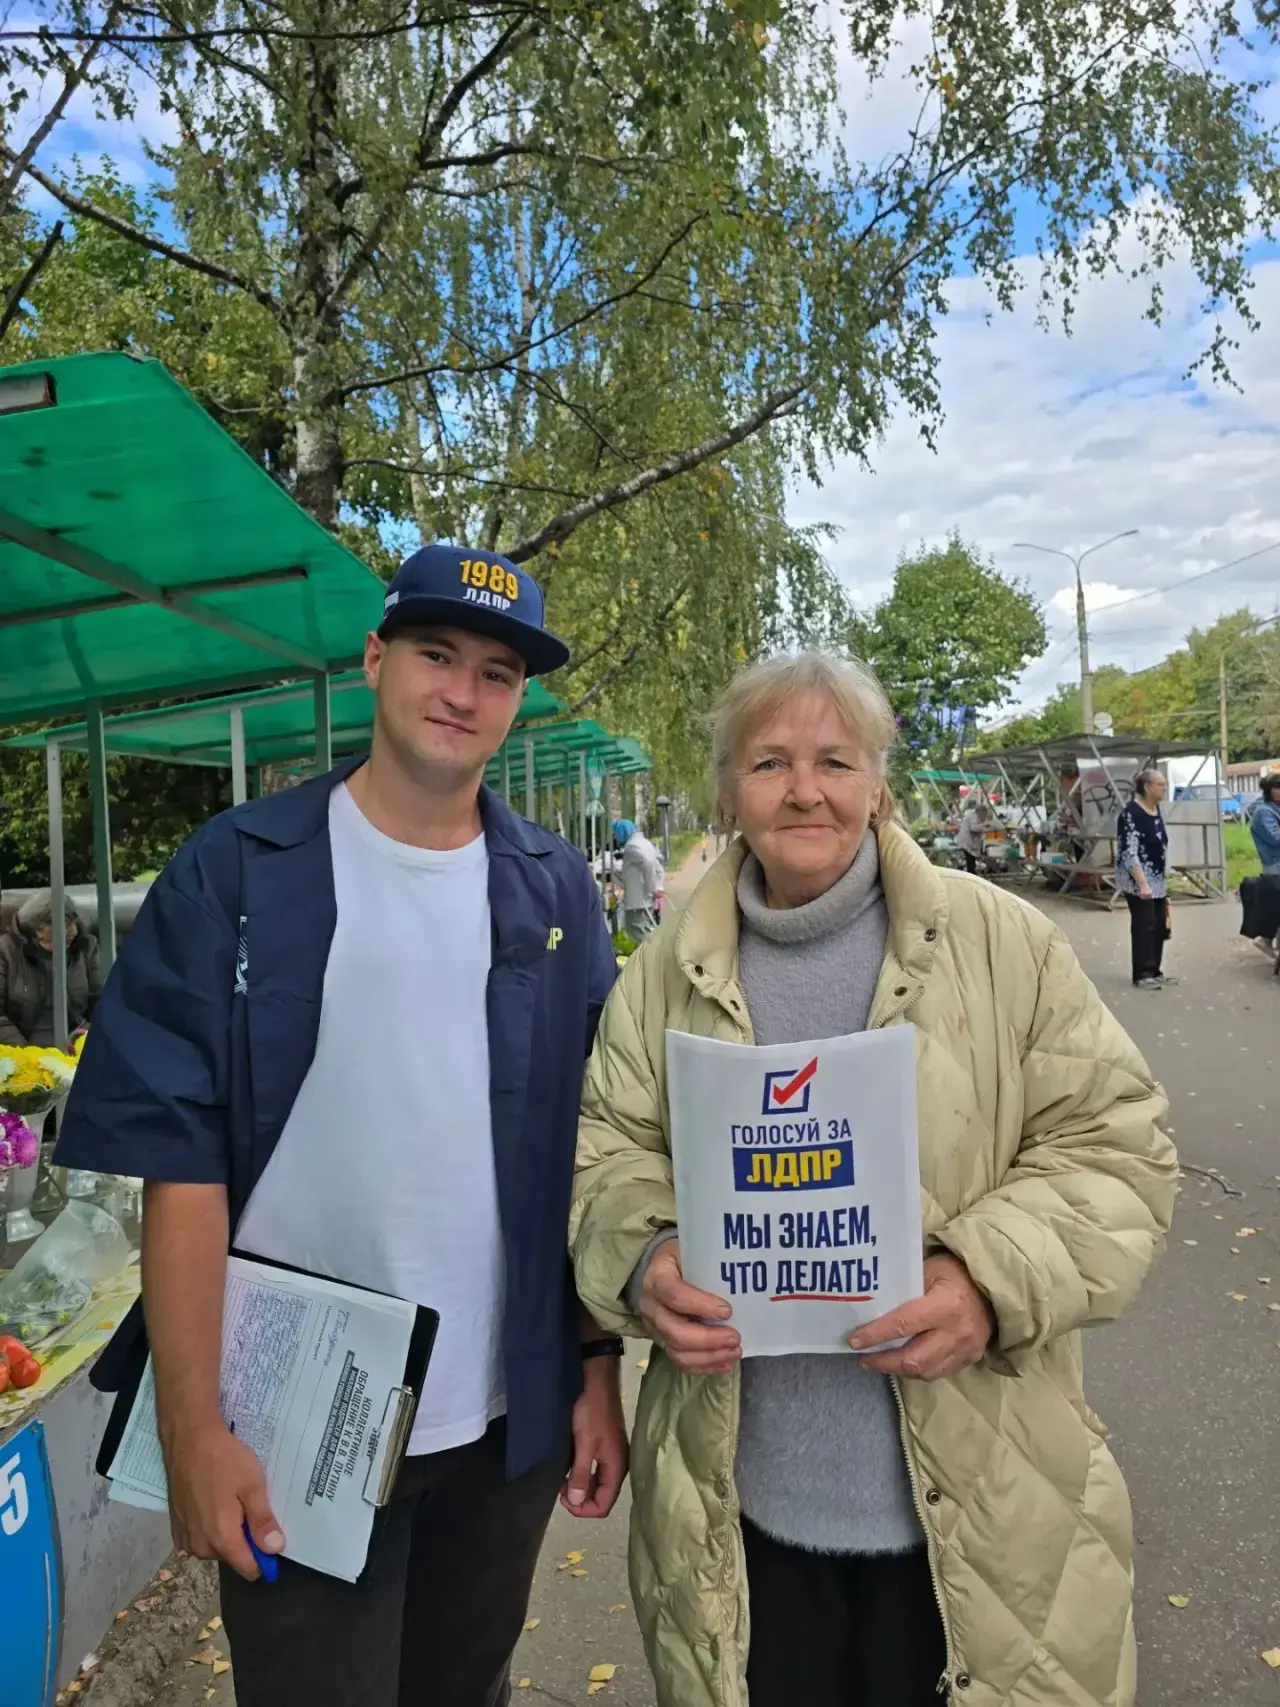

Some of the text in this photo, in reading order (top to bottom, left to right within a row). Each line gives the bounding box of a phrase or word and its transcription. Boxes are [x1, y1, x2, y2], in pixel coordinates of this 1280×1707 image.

[459, 559, 519, 601] 1989
[462, 587, 511, 611] ЛДПР
[730, 1117, 852, 1145] ГОЛОСУЙ ЗА
[746, 1148, 843, 1188] ЛДПР
[723, 1204, 877, 1250] МЫ ЗНАЕМ,
[720, 1255, 879, 1295] ЧТО ДЕЛАТЬ!
[324, 1369, 368, 1501] ОБРАЩЕНИЕ К В.В. ПУТИНУ
[343, 1396, 372, 1477] КОЛЛЕКТИВНОЕ
[0, 1451, 29, 1536] 5
